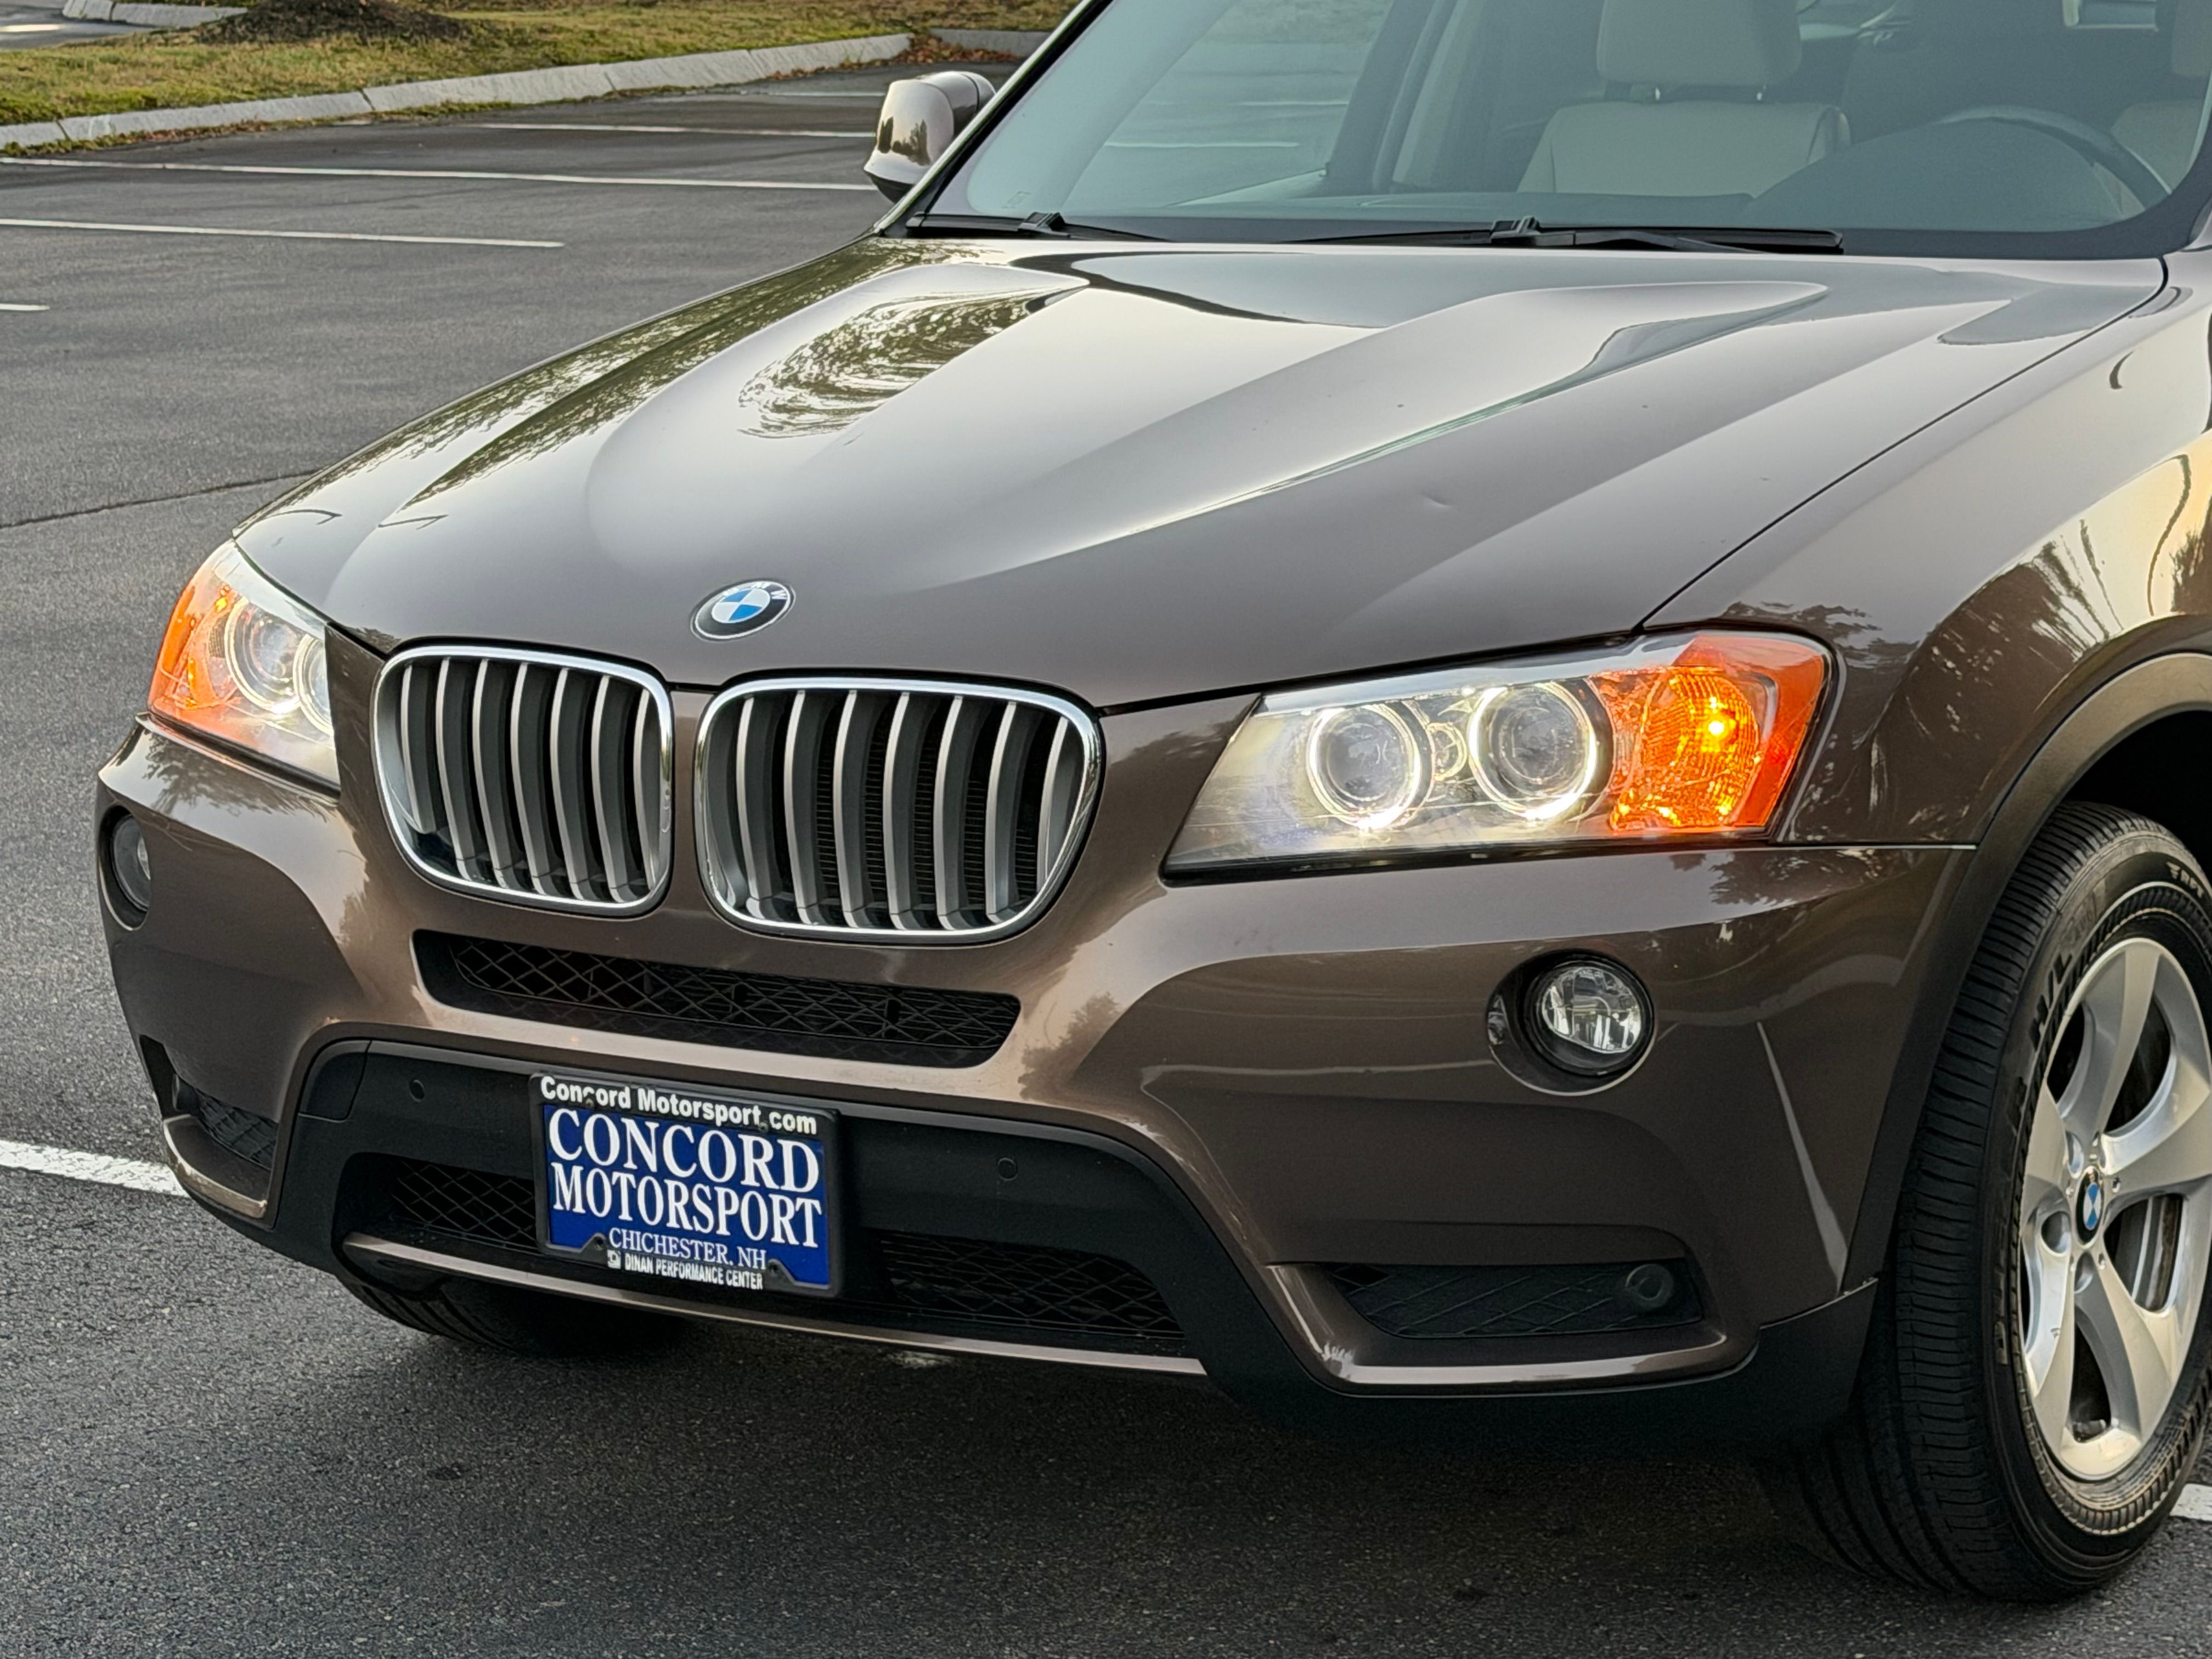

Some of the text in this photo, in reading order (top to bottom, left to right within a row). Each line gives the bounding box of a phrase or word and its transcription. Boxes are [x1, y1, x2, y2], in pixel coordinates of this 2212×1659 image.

[540, 1076, 816, 1135] Concord Motorsportcom
[549, 1108, 819, 1193] CONCORD
[551, 1161, 822, 1248] MOTORSPORT
[624, 1252, 653, 1274] DINAN
[656, 1258, 724, 1285] PERFORMANCE
[726, 1269, 763, 1290] CENTER
[737, 1246, 766, 1270] NH
